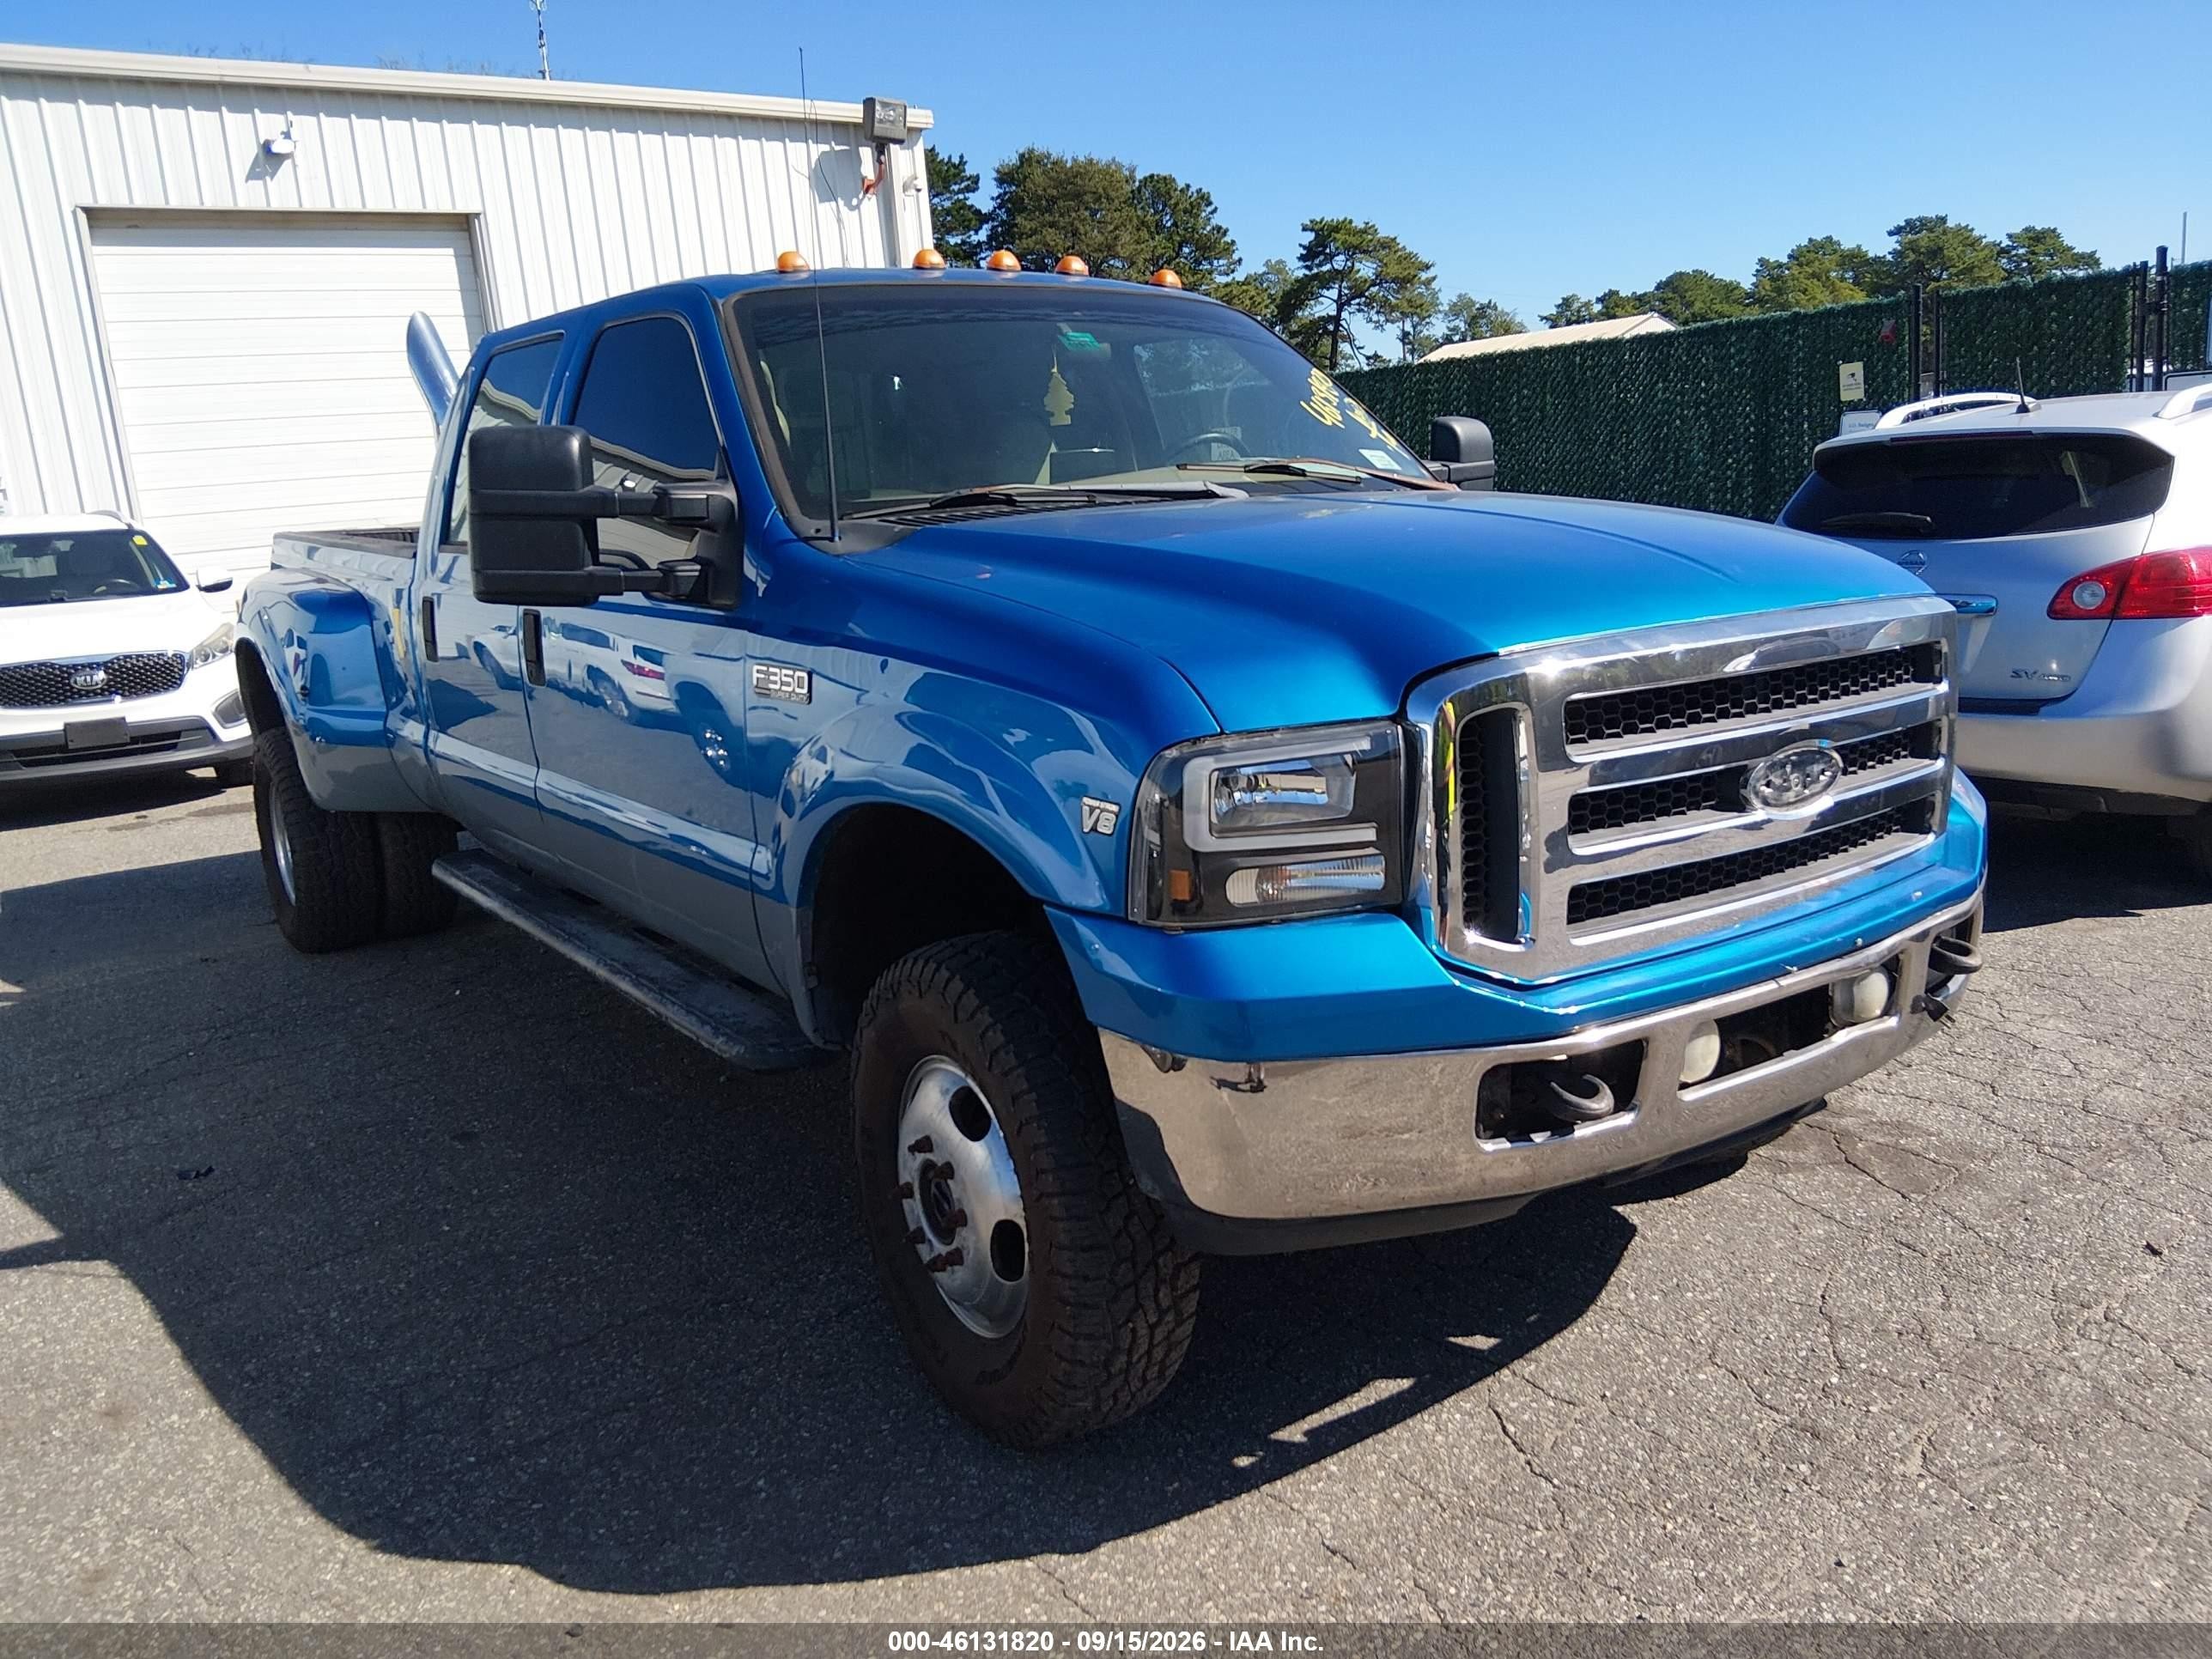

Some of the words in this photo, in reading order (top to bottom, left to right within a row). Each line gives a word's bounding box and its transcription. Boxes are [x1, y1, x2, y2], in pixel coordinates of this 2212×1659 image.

[76, 674, 102, 685] KIA
[752, 665, 809, 694] F350
[1083, 805, 1116, 834] V8
